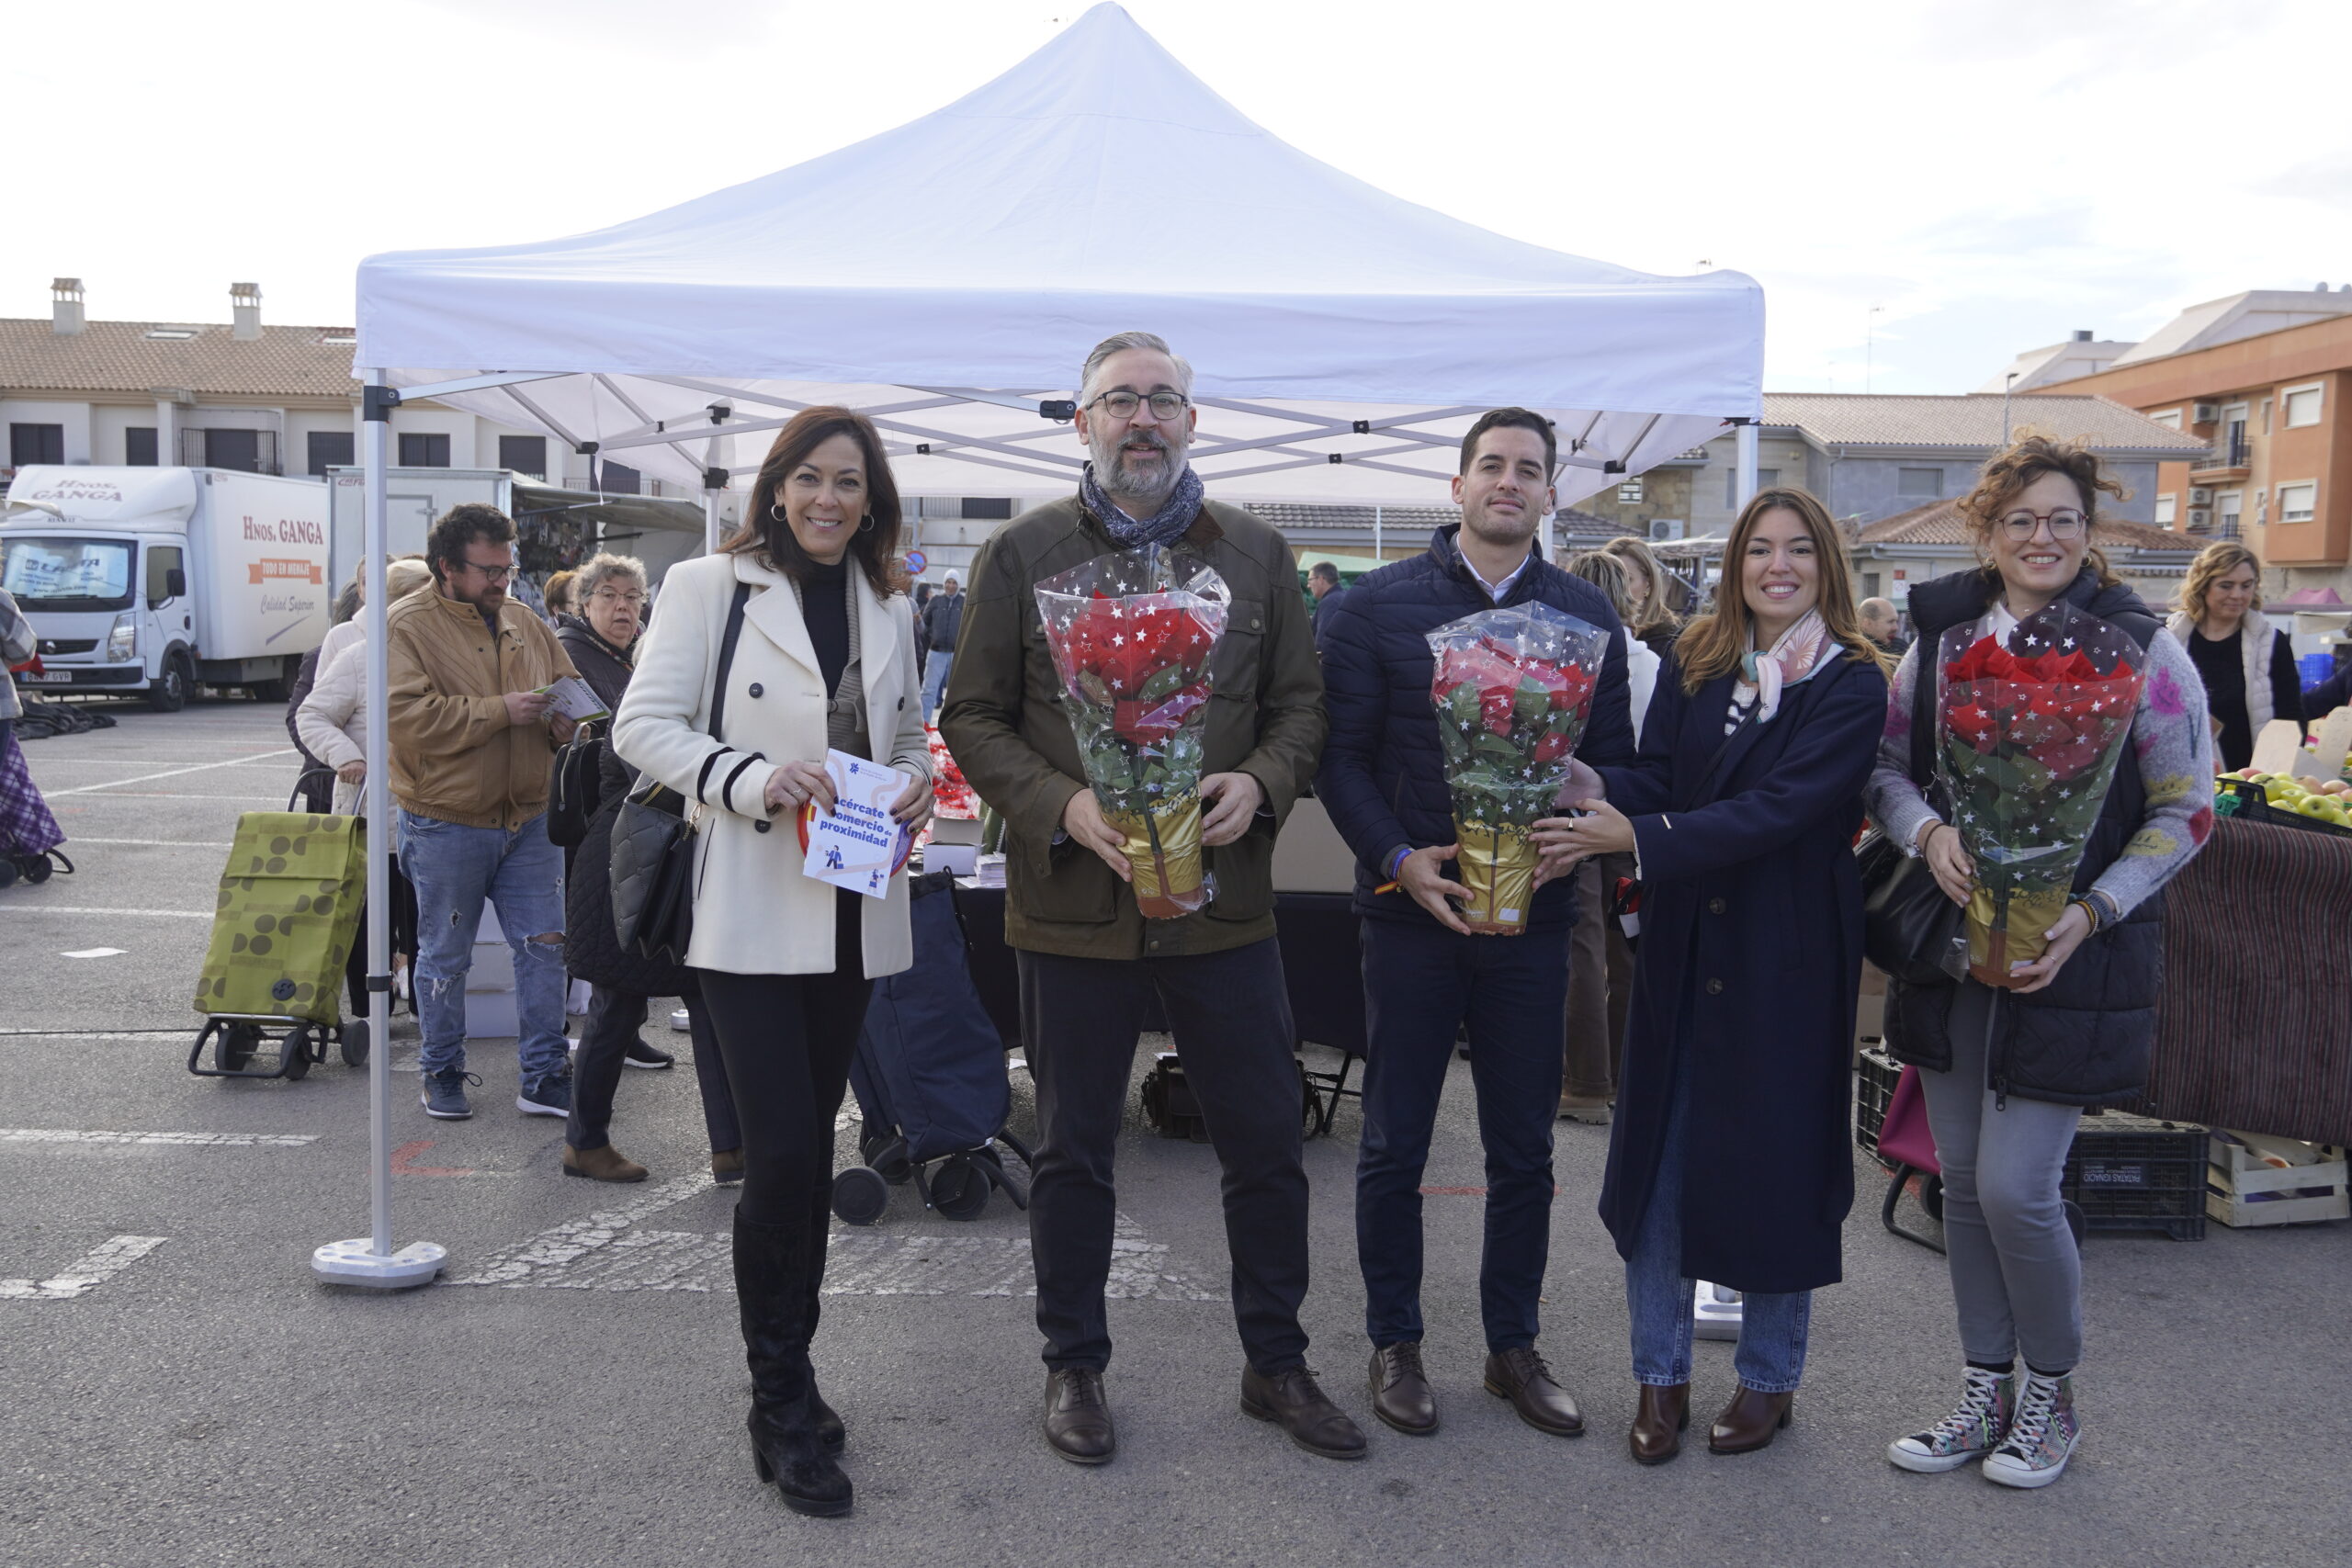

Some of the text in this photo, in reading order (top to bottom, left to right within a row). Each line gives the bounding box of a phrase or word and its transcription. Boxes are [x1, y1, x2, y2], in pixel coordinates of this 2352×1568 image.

[31, 490, 123, 502] GANGA
[279, 519, 323, 545] GANGA
[263, 562, 310, 576] TODO EN MENAJE
[260, 594, 314, 615] Calidad Superior
[837, 798, 885, 818] cércate
[834, 812, 884, 832] omercio
[820, 820, 888, 848] proximidad
[2083, 1174, 2141, 1182] PATATAS IGNACIO
